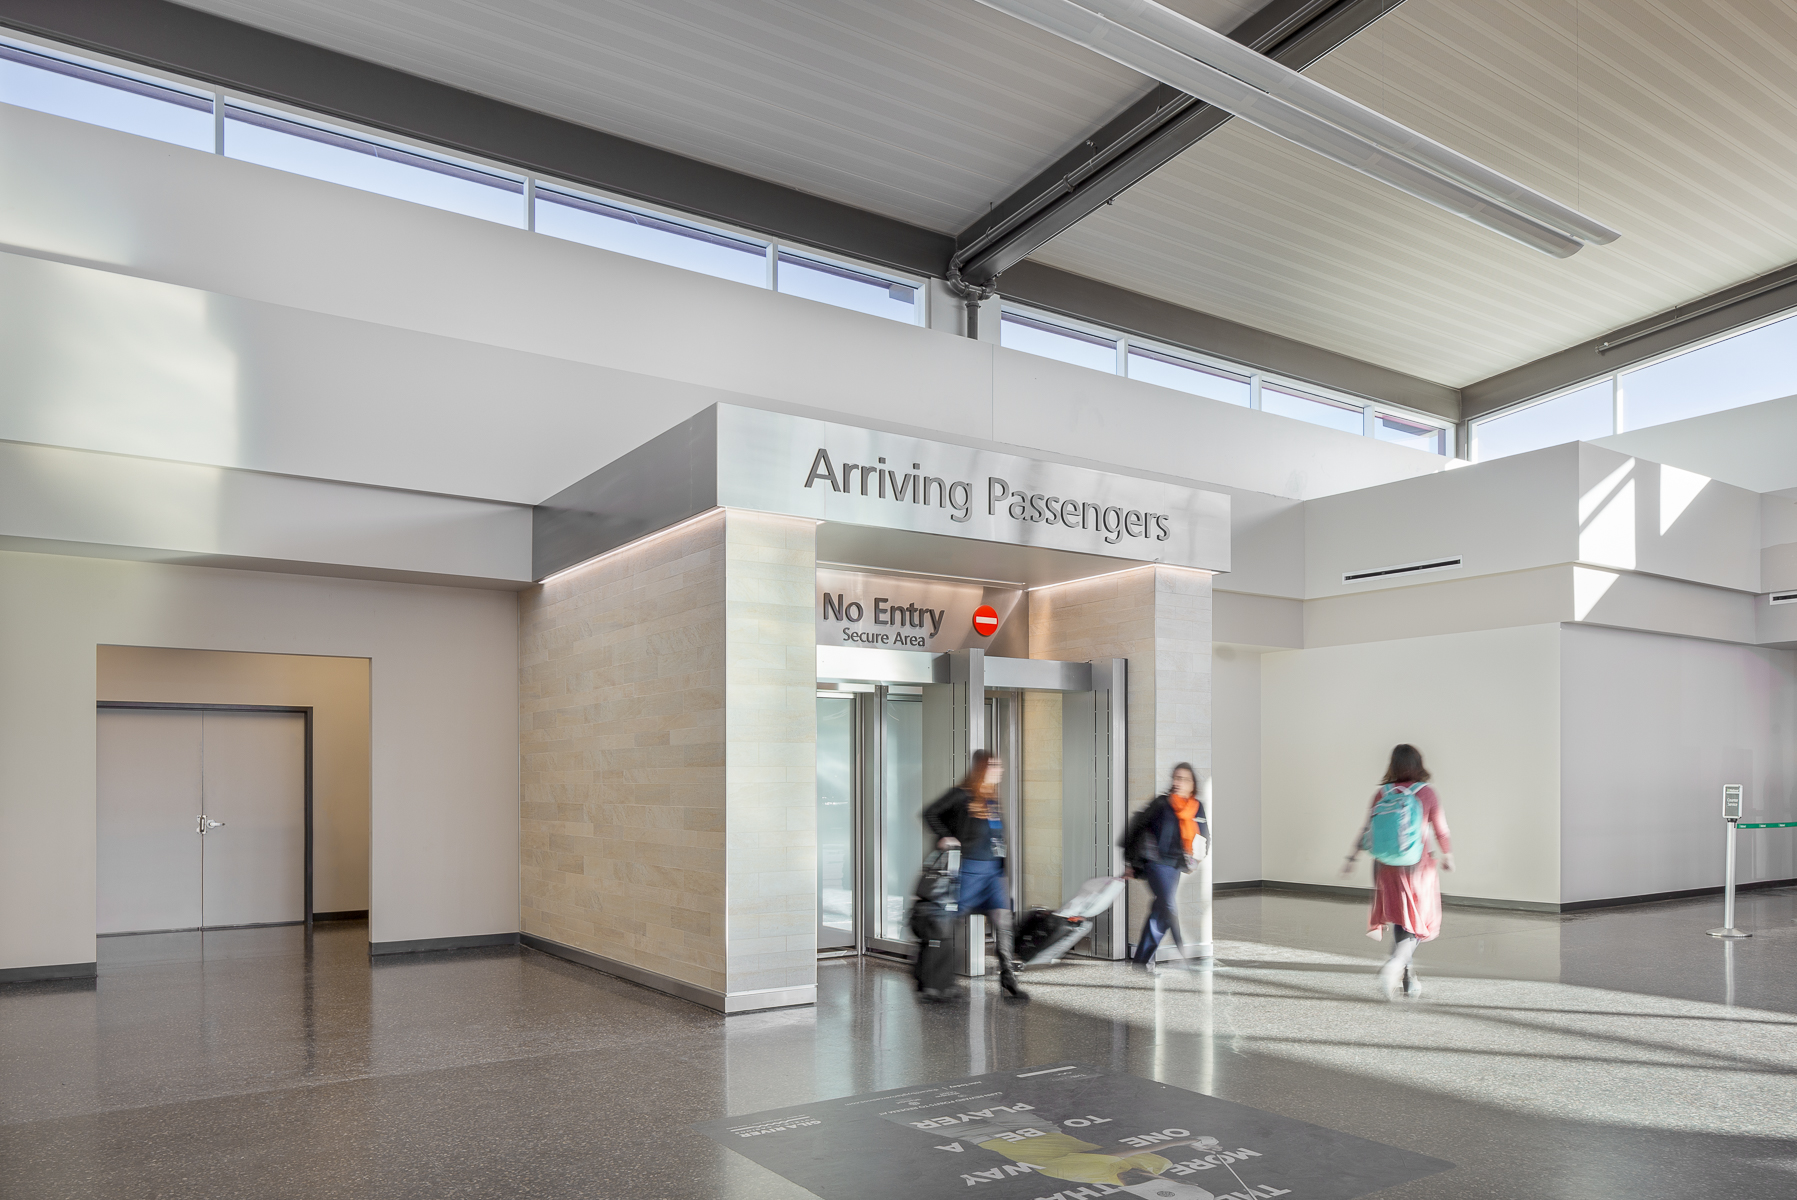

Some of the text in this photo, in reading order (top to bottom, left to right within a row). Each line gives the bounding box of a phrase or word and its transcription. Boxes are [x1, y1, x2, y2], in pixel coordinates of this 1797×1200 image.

[804, 448, 1171, 544] Arriving Passengers
[823, 592, 945, 638] No Entry
[843, 627, 926, 648] Secure Area
[785, 1120, 822, 1130] GILA
[908, 1102, 1035, 1129] PLAYER
[740, 1126, 787, 1138] RIVER
[933, 1115, 1112, 1154] TO BE A
[960, 1128, 1190, 1186] ONE WAY
[1169, 1148, 1263, 1177] MORE
